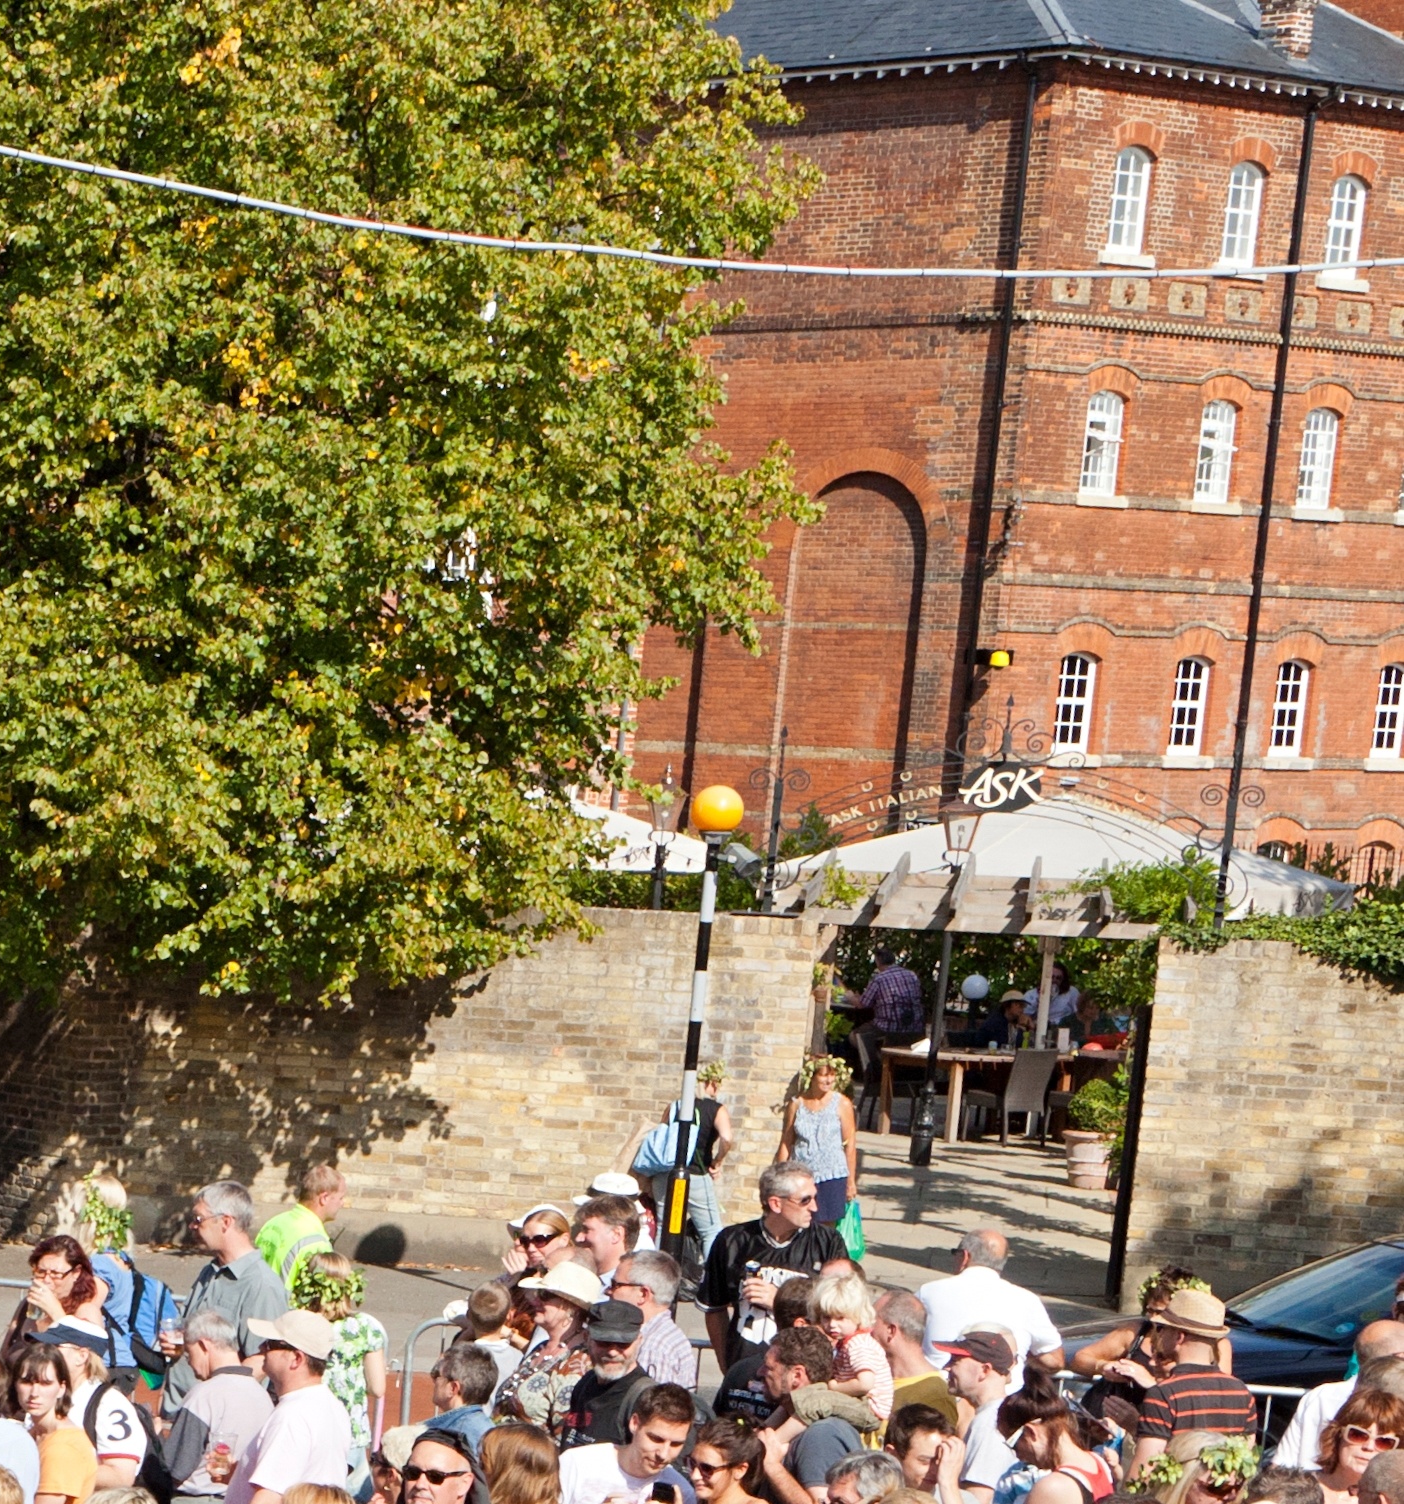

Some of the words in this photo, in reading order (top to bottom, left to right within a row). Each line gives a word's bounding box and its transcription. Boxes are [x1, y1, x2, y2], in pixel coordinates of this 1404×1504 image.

[959, 768, 1044, 809] ASK
[830, 806, 864, 827] ASK
[107, 1409, 132, 1441] 3
